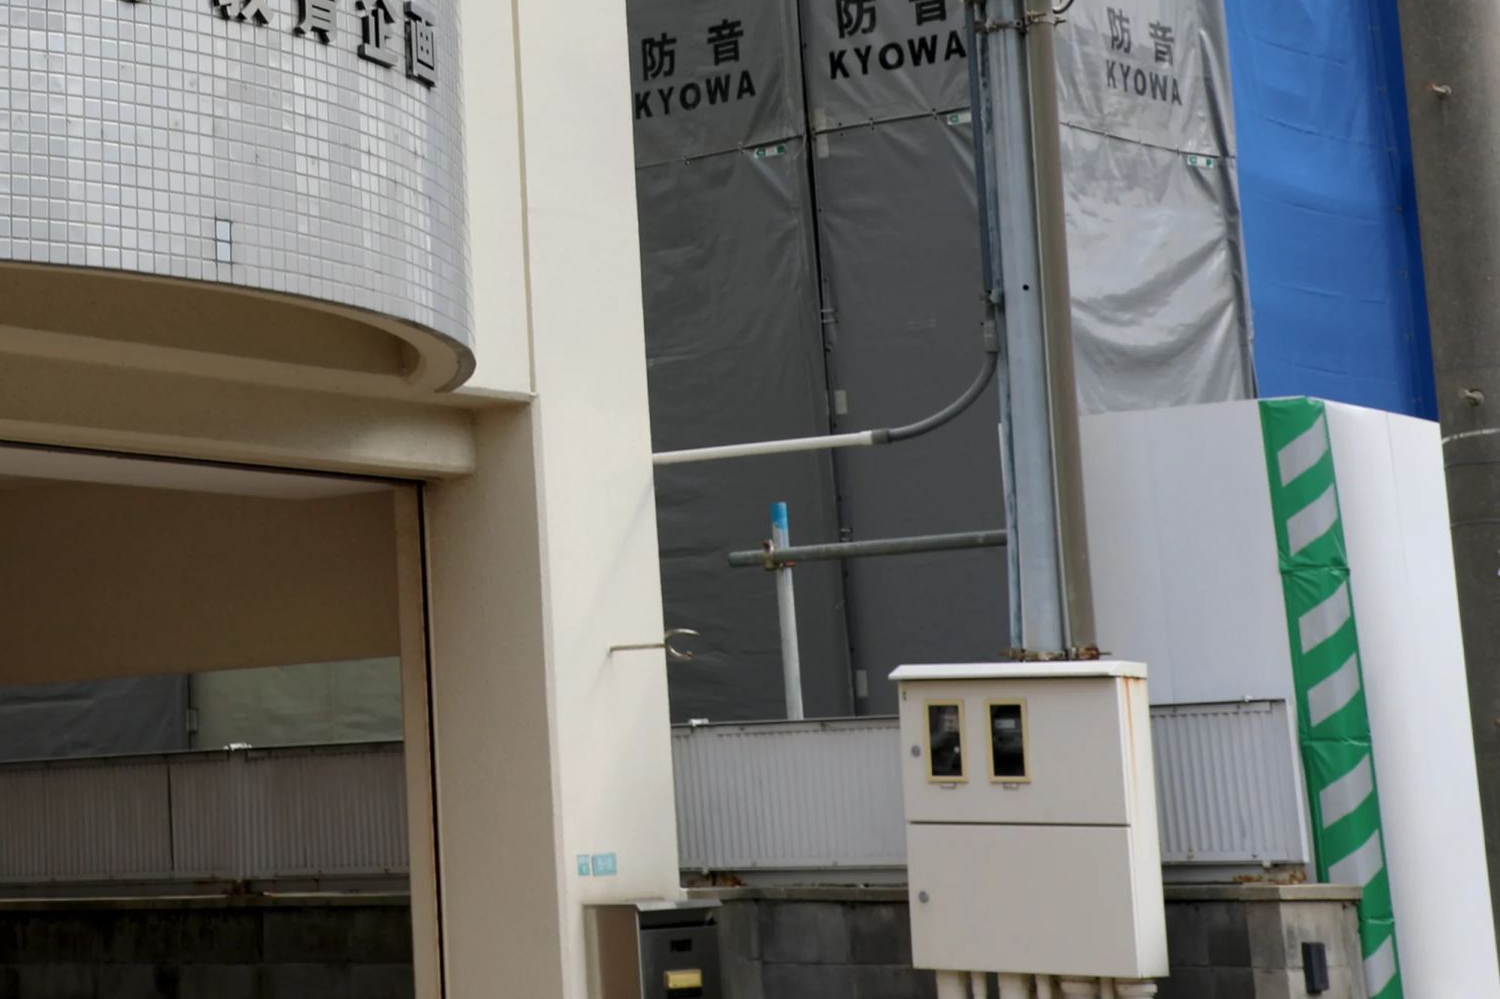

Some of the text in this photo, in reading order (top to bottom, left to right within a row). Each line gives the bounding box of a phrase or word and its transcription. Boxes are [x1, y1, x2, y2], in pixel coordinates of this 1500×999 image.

[640, 18, 745, 81] 防音
[828, 30, 967, 81] KYOWA
[1105, 6, 1176, 67] 防音
[634, 68, 756, 120] KYOWA
[1105, 59, 1183, 108] KYOWA
